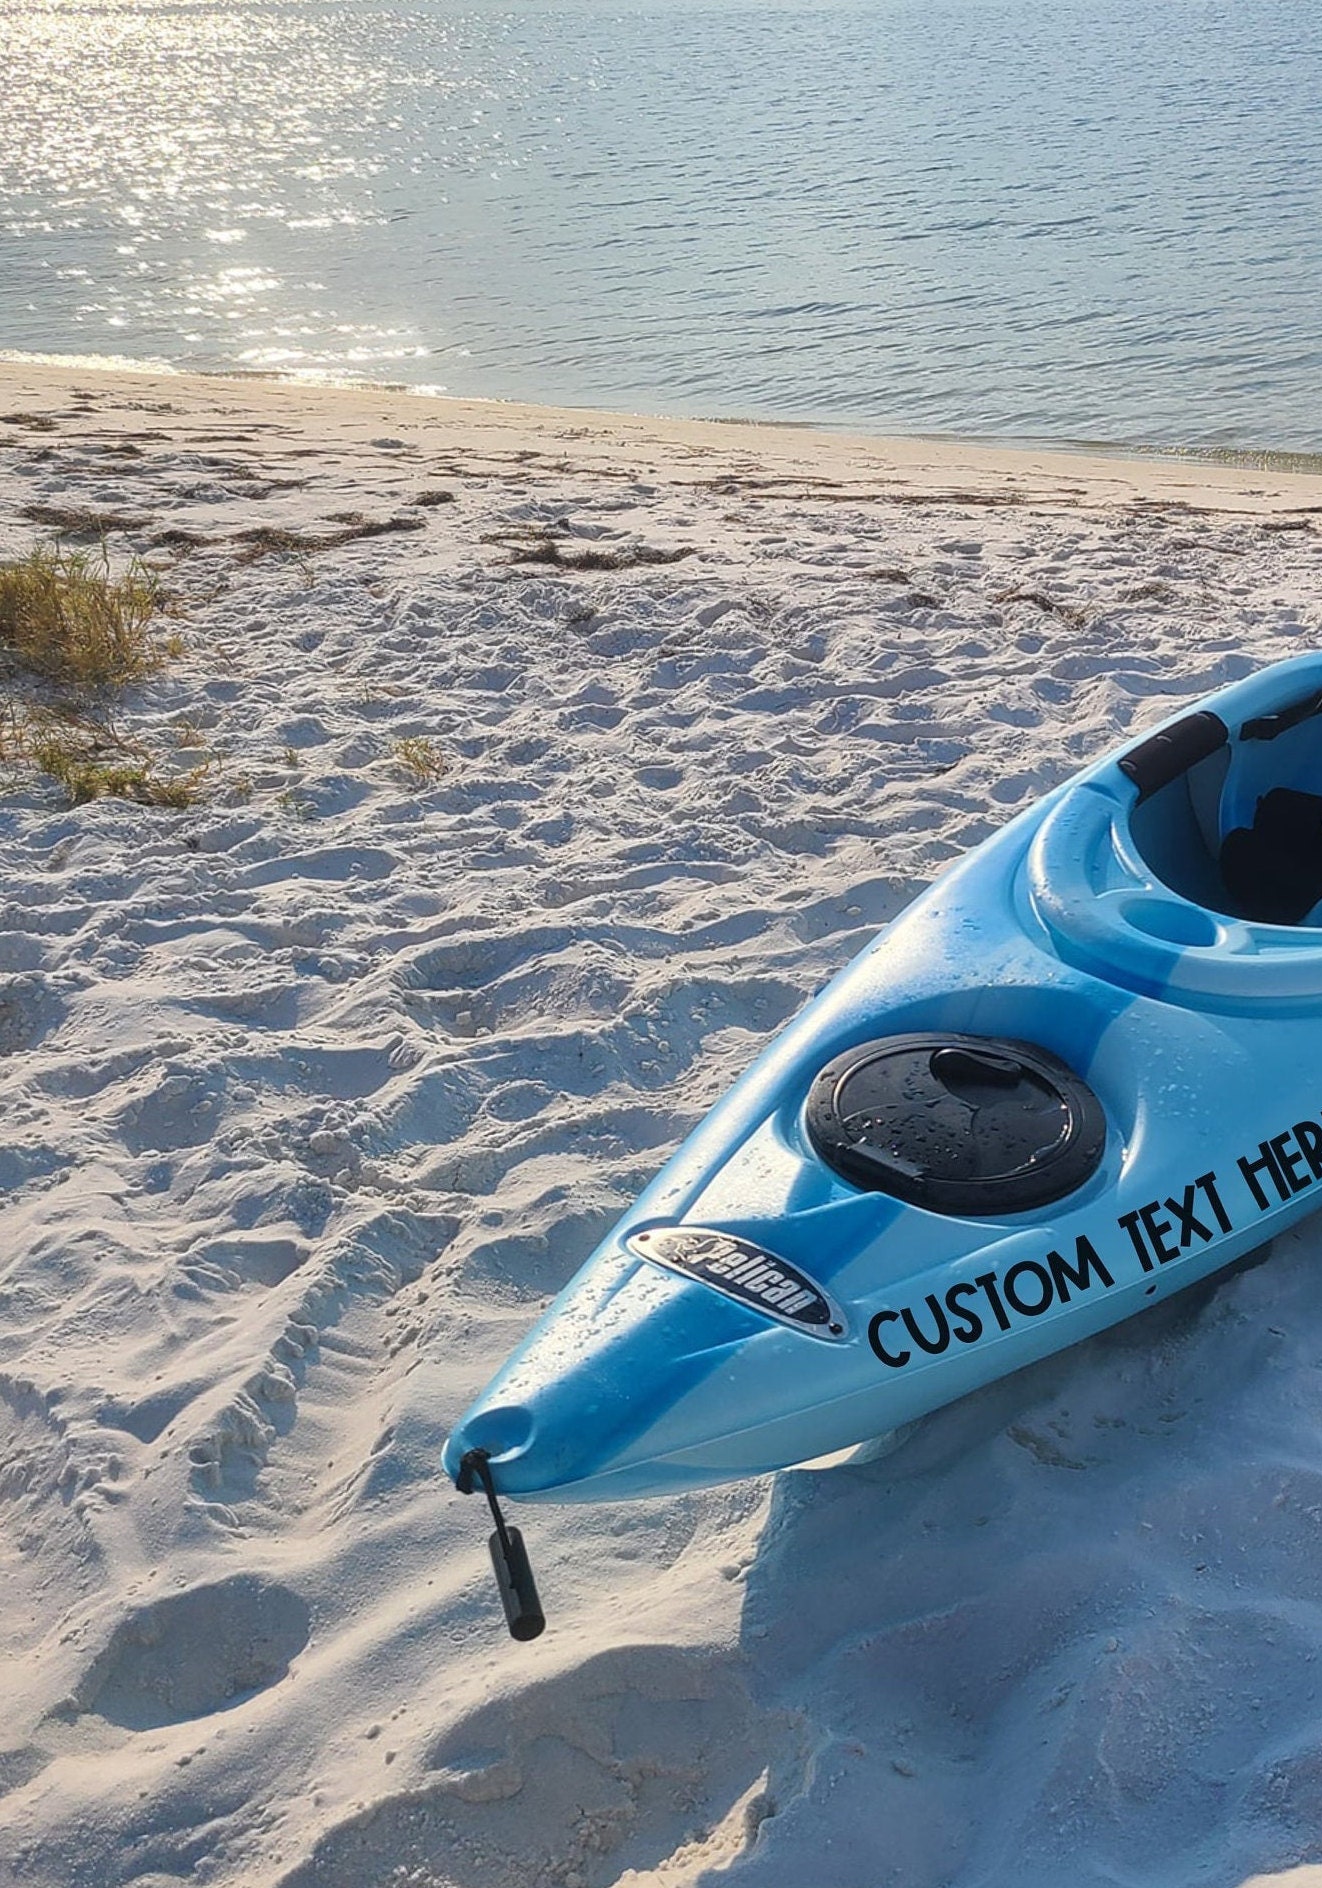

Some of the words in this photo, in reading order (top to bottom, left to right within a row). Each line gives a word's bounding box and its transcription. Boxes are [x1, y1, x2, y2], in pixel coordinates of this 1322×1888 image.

[687, 1236, 818, 1315] Pelican
[867, 1235, 1115, 1368] CUSTOM
[1117, 1171, 1234, 1273] TEXT
